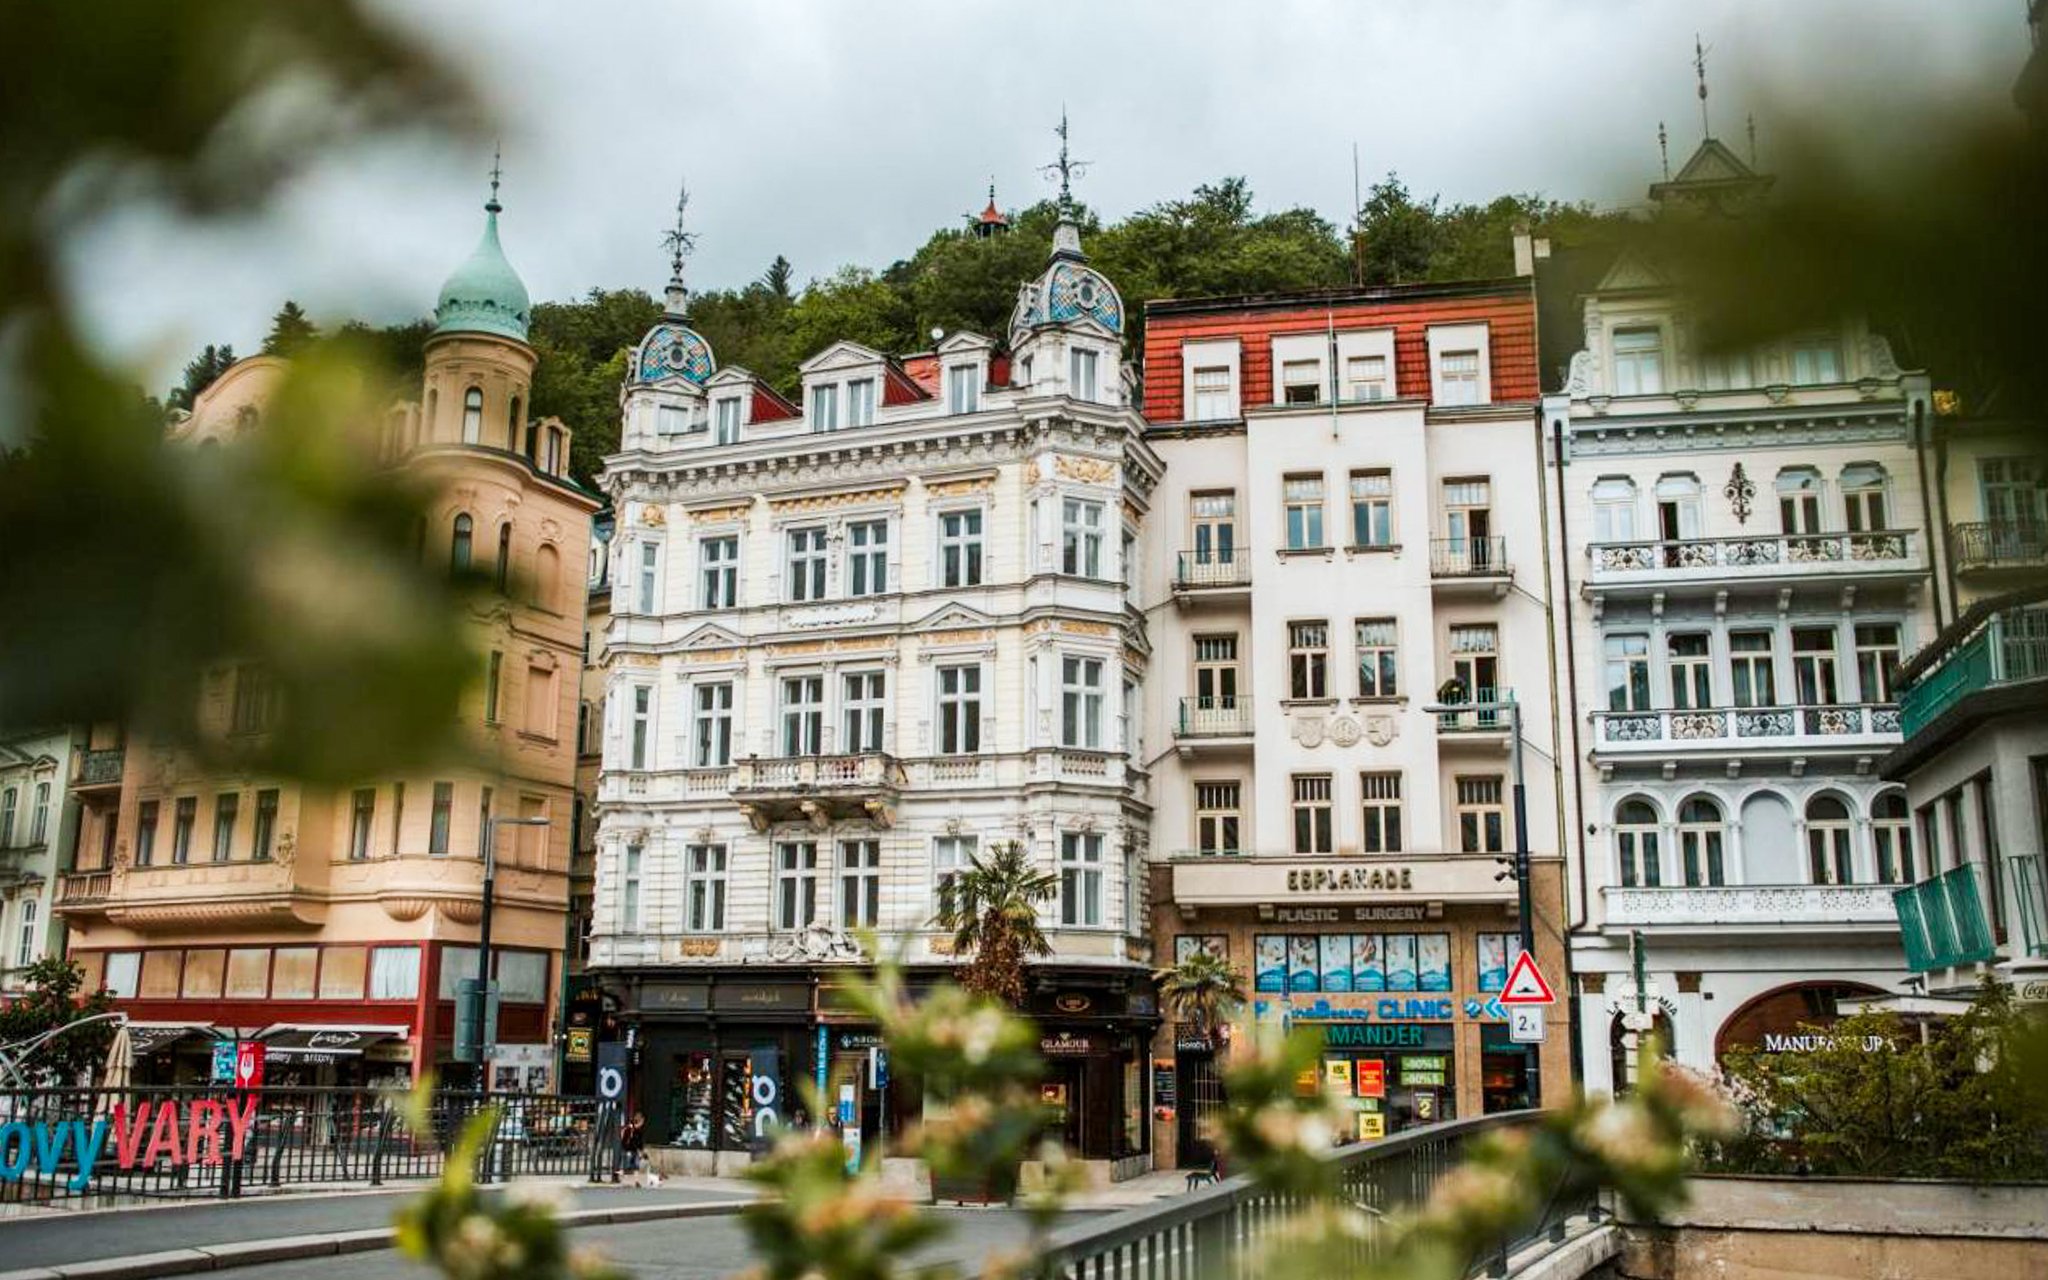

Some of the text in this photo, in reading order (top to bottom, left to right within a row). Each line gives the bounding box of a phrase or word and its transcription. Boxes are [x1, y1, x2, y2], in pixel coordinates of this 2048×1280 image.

[1287, 867, 1412, 891] ESPLANADE
[1278, 906, 1425, 923] PLASTIC SURGERY
[1377, 998, 1453, 1019] CLINIC
[1518, 1016, 1527, 1031] 2
[1041, 1039, 1089, 1049] GLAMOUR
[114, 1094, 258, 1169] VARY
